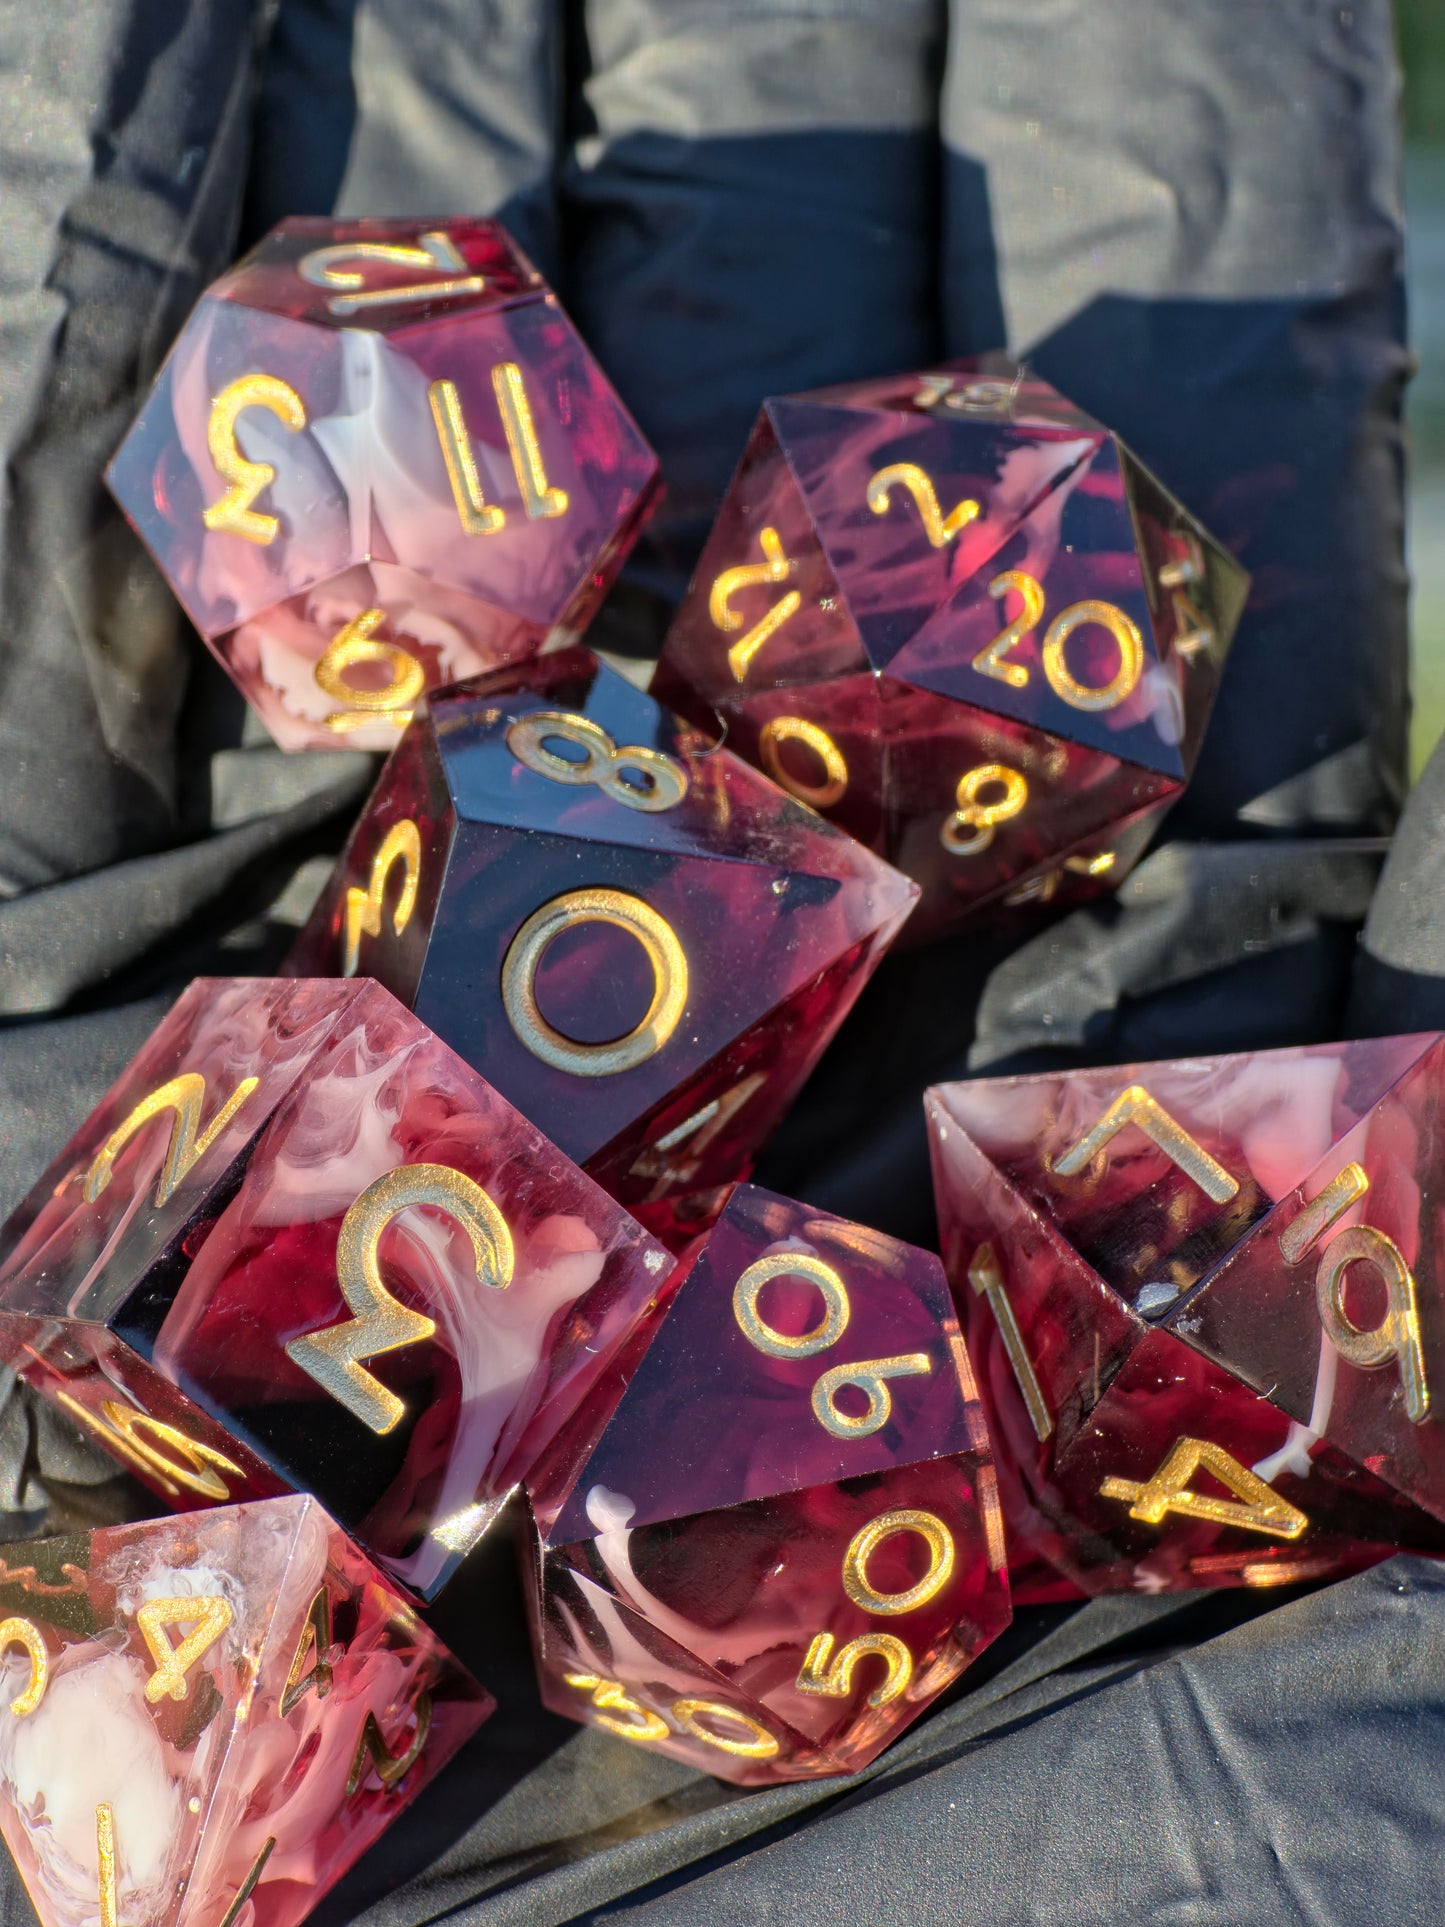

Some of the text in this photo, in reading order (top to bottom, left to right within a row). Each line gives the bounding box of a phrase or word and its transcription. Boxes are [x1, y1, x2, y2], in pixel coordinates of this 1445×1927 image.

[202, 374, 306, 545] 3
[428, 363, 569, 536] 11
[866, 462, 979, 548] 2
[971, 569, 1144, 712] 20
[506, 710, 688, 813] 8
[501, 887, 689, 1078] 0
[82, 1072, 259, 1208] 2
[1053, 1085, 1240, 1204] 7
[284, 1162, 515, 1434] 3
[1099, 1436, 1309, 1539] 4
[136, 1596, 233, 1704] 4
[795, 1509, 956, 1708] 50
